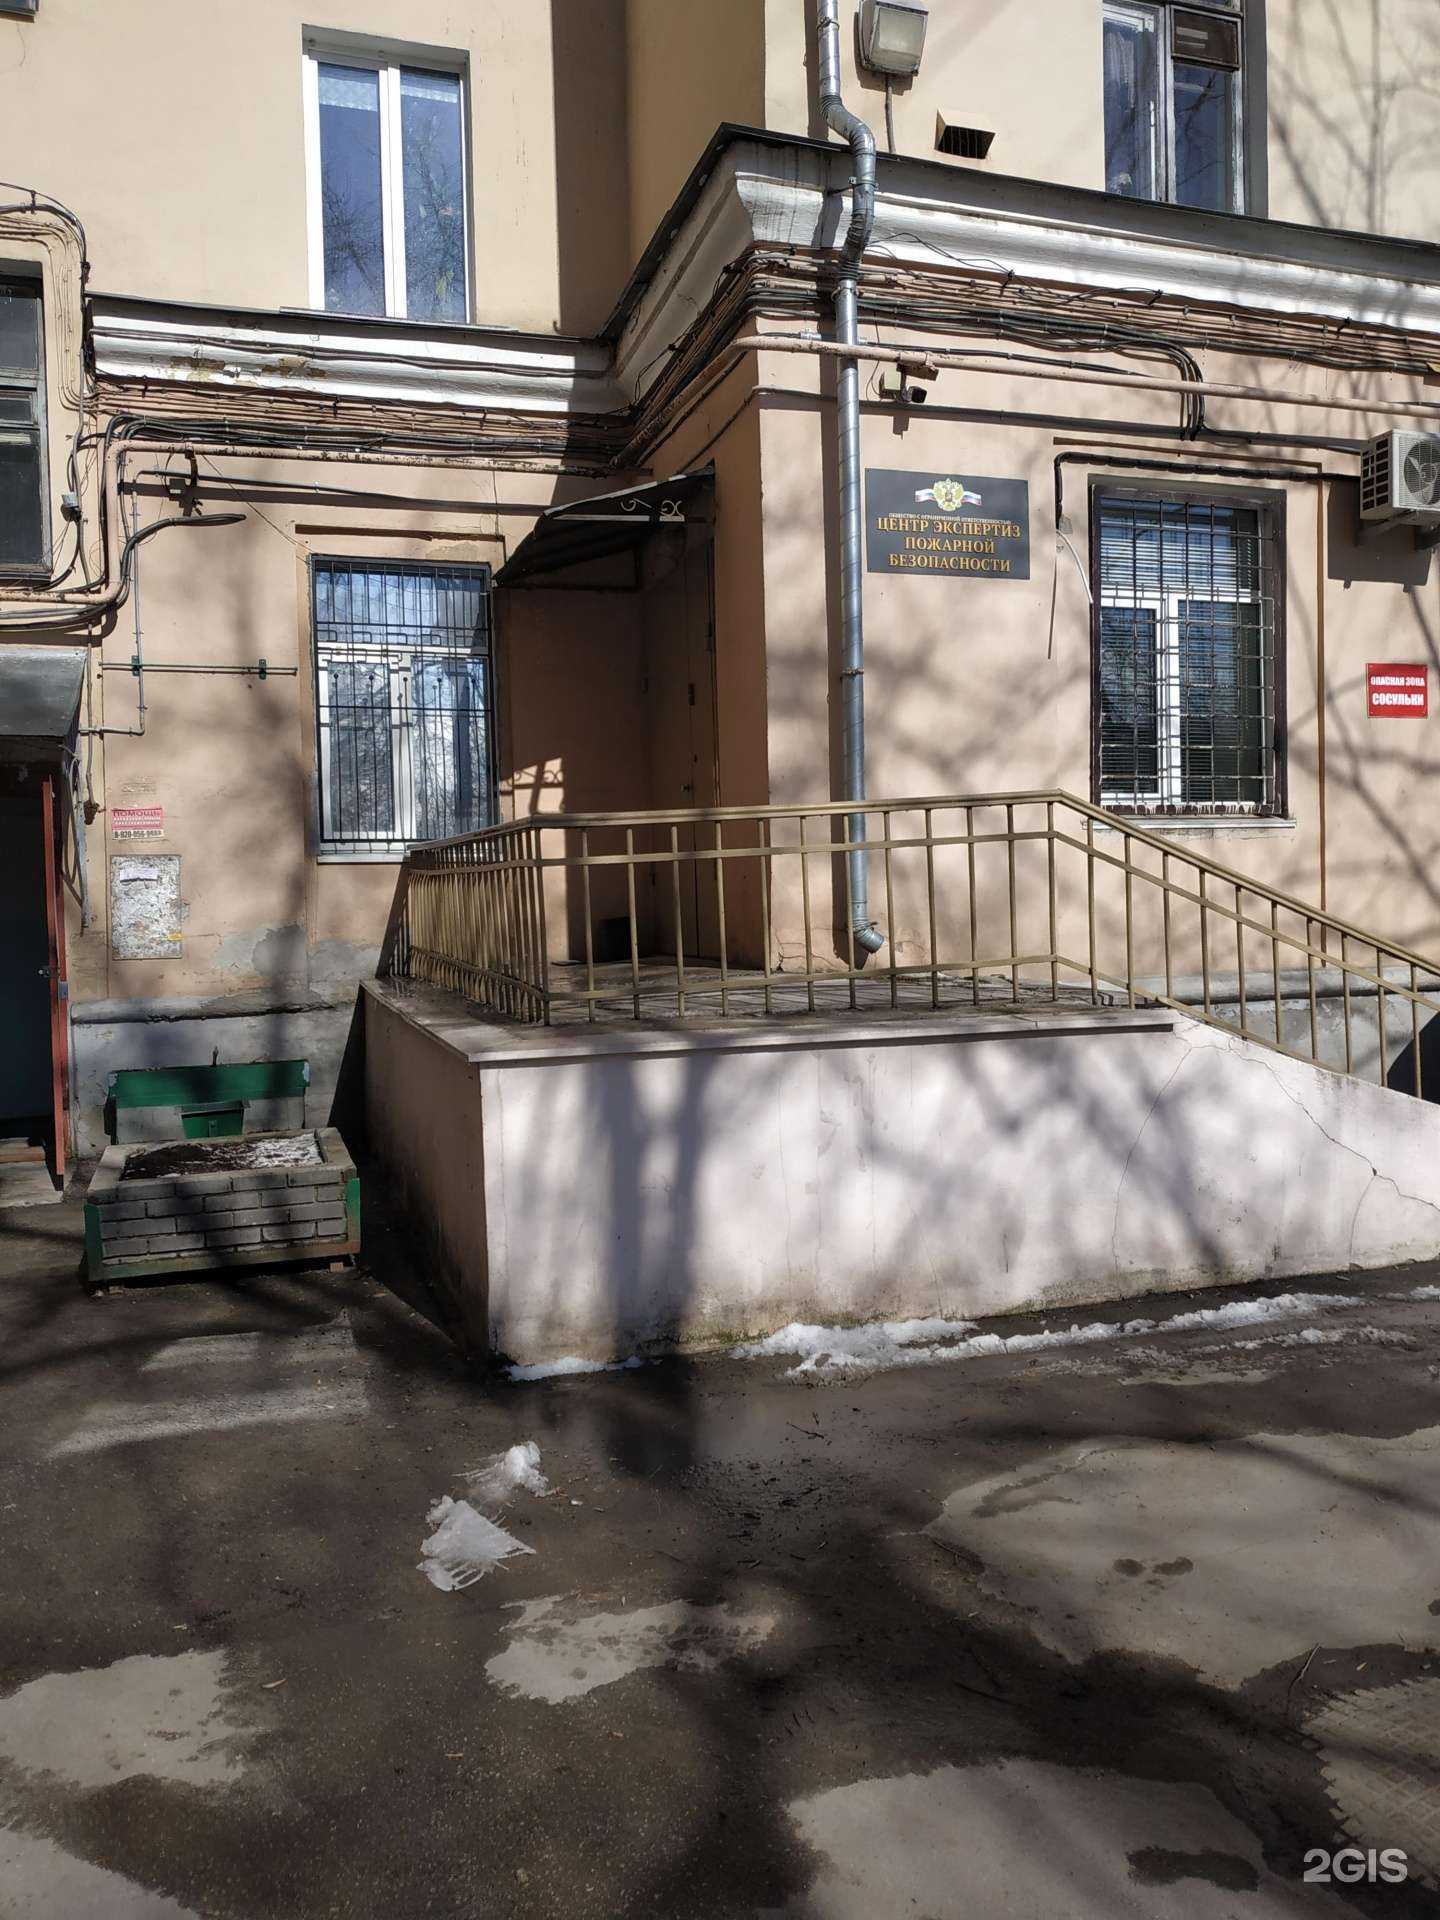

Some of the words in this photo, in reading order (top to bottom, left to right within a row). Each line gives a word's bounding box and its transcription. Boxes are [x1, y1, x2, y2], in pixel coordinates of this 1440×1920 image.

[877, 517, 928, 533] ЦЕНТР
[933, 520, 1020, 538] ЭКСПЕРТИЗ
[905, 536, 995, 554] ПОЖАРНОЙ
[888, 553, 1011, 572] БЕЗОПАСНОСТИ
[1370, 676, 1404, 686] ОПАСНАЯ
[1405, 677, 1425, 687] ЗОНА
[1372, 693, 1424, 706] СОСУЛЬКИ
